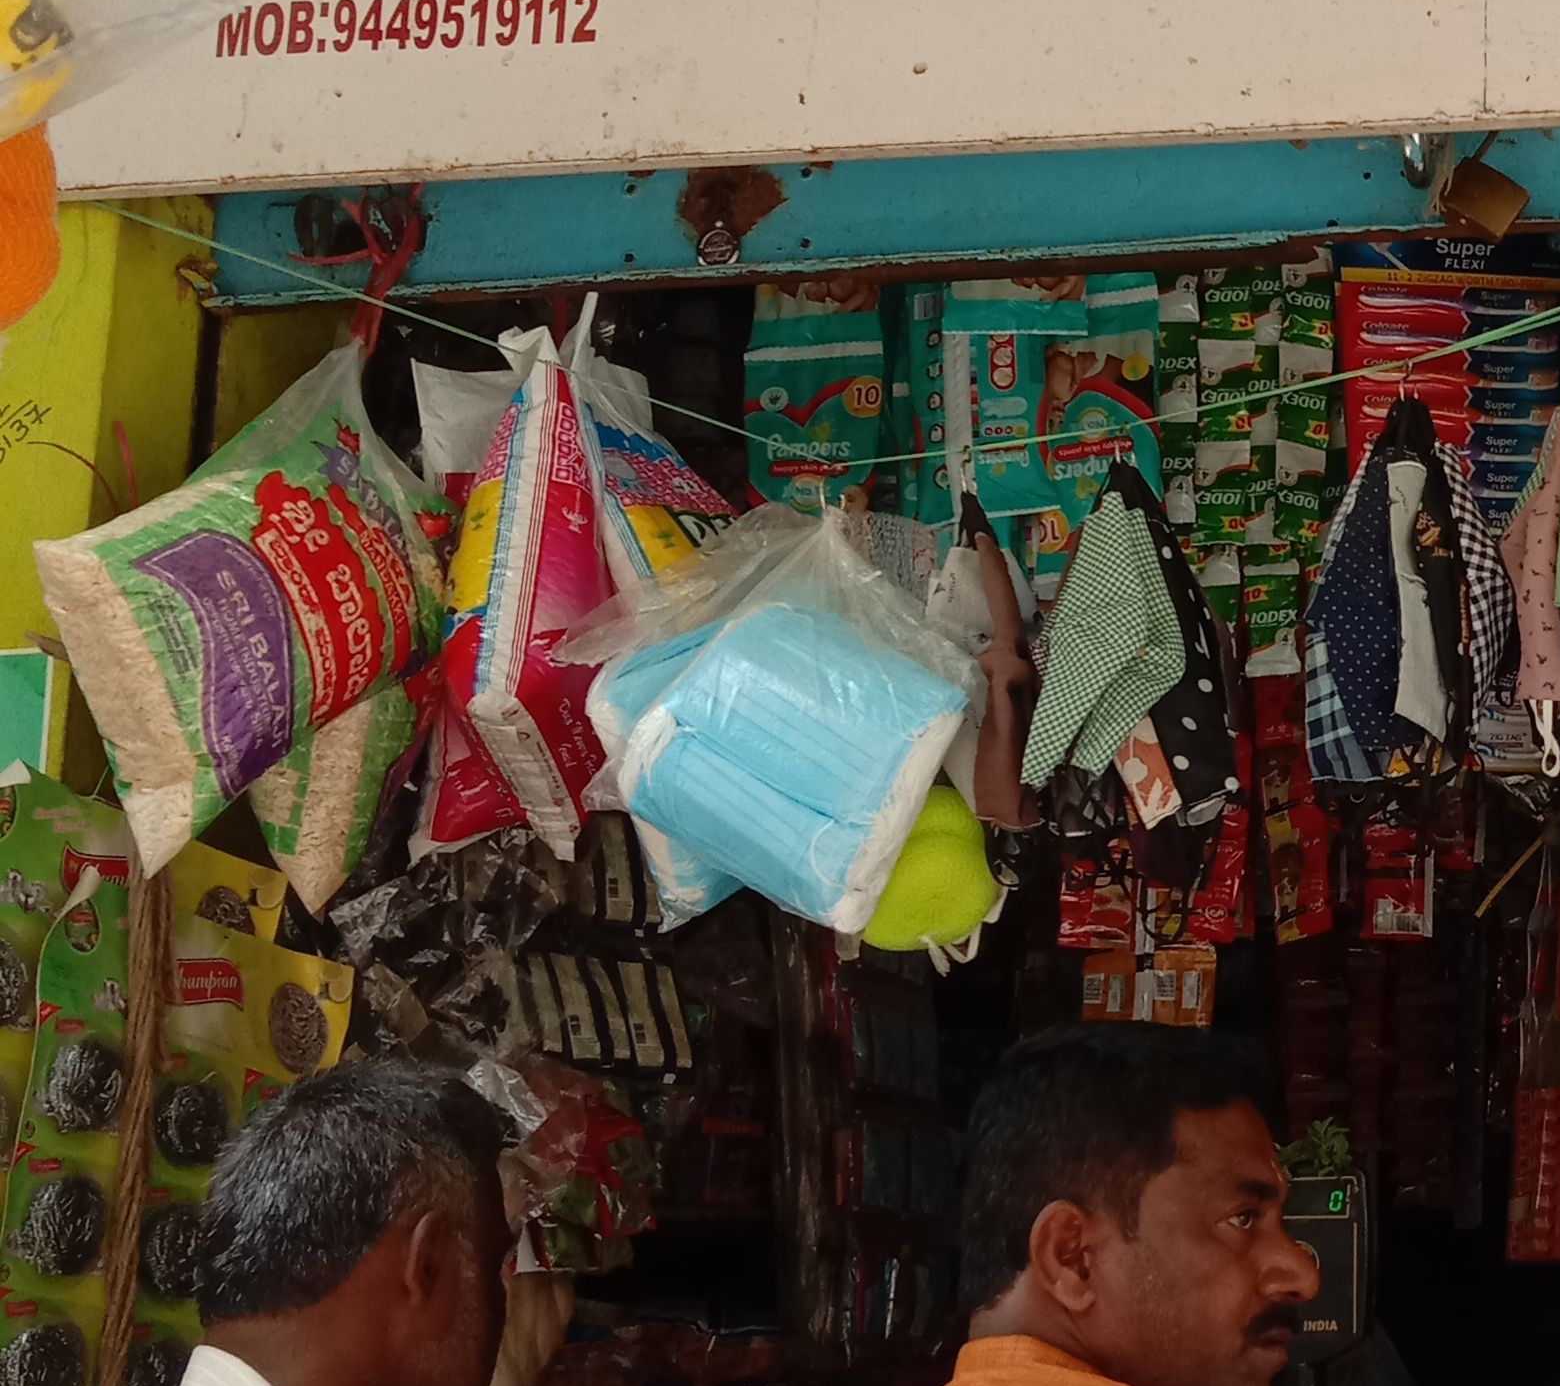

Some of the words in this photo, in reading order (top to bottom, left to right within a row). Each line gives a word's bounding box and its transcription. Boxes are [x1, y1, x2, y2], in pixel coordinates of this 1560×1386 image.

[1435, 238, 1495, 258] Super
[1444, 258, 1485, 269] FLEXI
[1483, 363, 1515, 374] Super
[854, 387, 880, 405] 10
[1281, 391, 1328, 411] IODEX
[1364, 394, 1397, 403] Colg
[1484, 400, 1516, 411] Super
[767, 433, 850, 461] Pampers
[1485, 436, 1518, 447] Super
[1486, 473, 1519, 484] Super
[1488, 509, 1509, 521] Sup
[268, 499, 330, 552] ಶ್ರೀ
[1244, 587, 1262, 601] 10
[1251, 609, 1298, 625] IODEX
[214, 566, 259, 629] SRI
[247, 631, 290, 748] BALAJI
[178, 966, 239, 999] hampion
[1328, 1189, 1345, 1213] 0
[1303, 1320, 1340, 1333] INDIA
